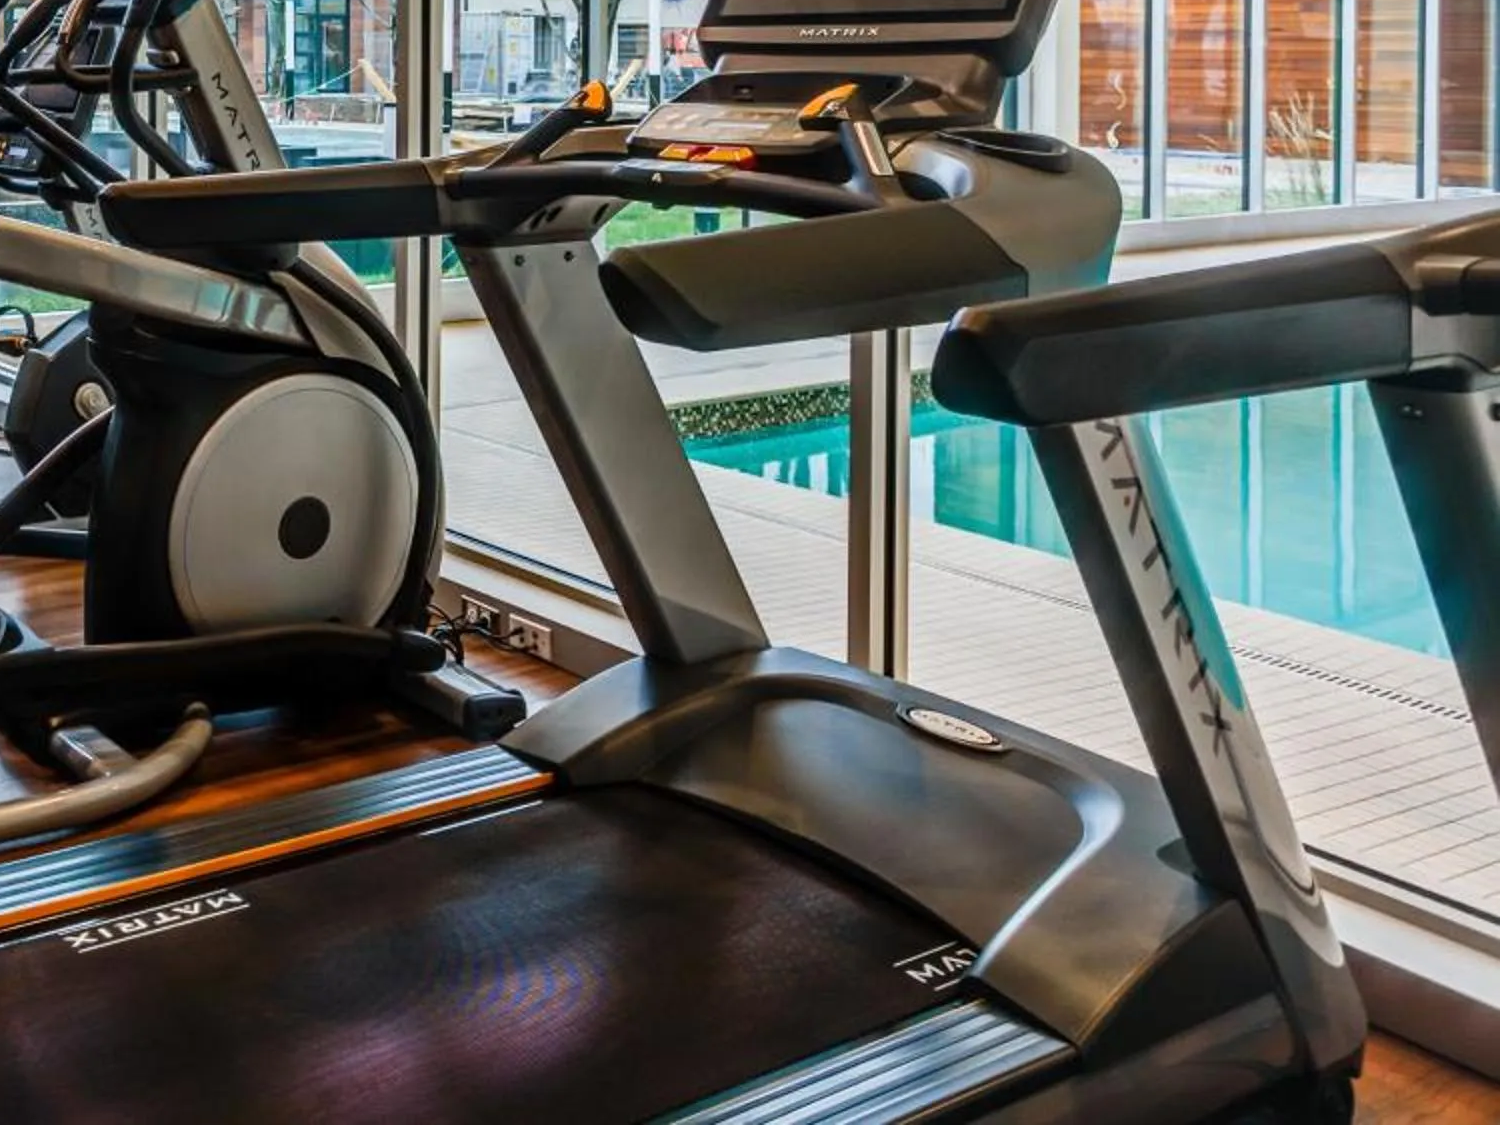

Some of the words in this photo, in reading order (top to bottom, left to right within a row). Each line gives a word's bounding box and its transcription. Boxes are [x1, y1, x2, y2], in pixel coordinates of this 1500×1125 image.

[211, 72, 260, 172] MATR
[63, 891, 243, 948] MATRIX
[905, 948, 977, 984] MAT
